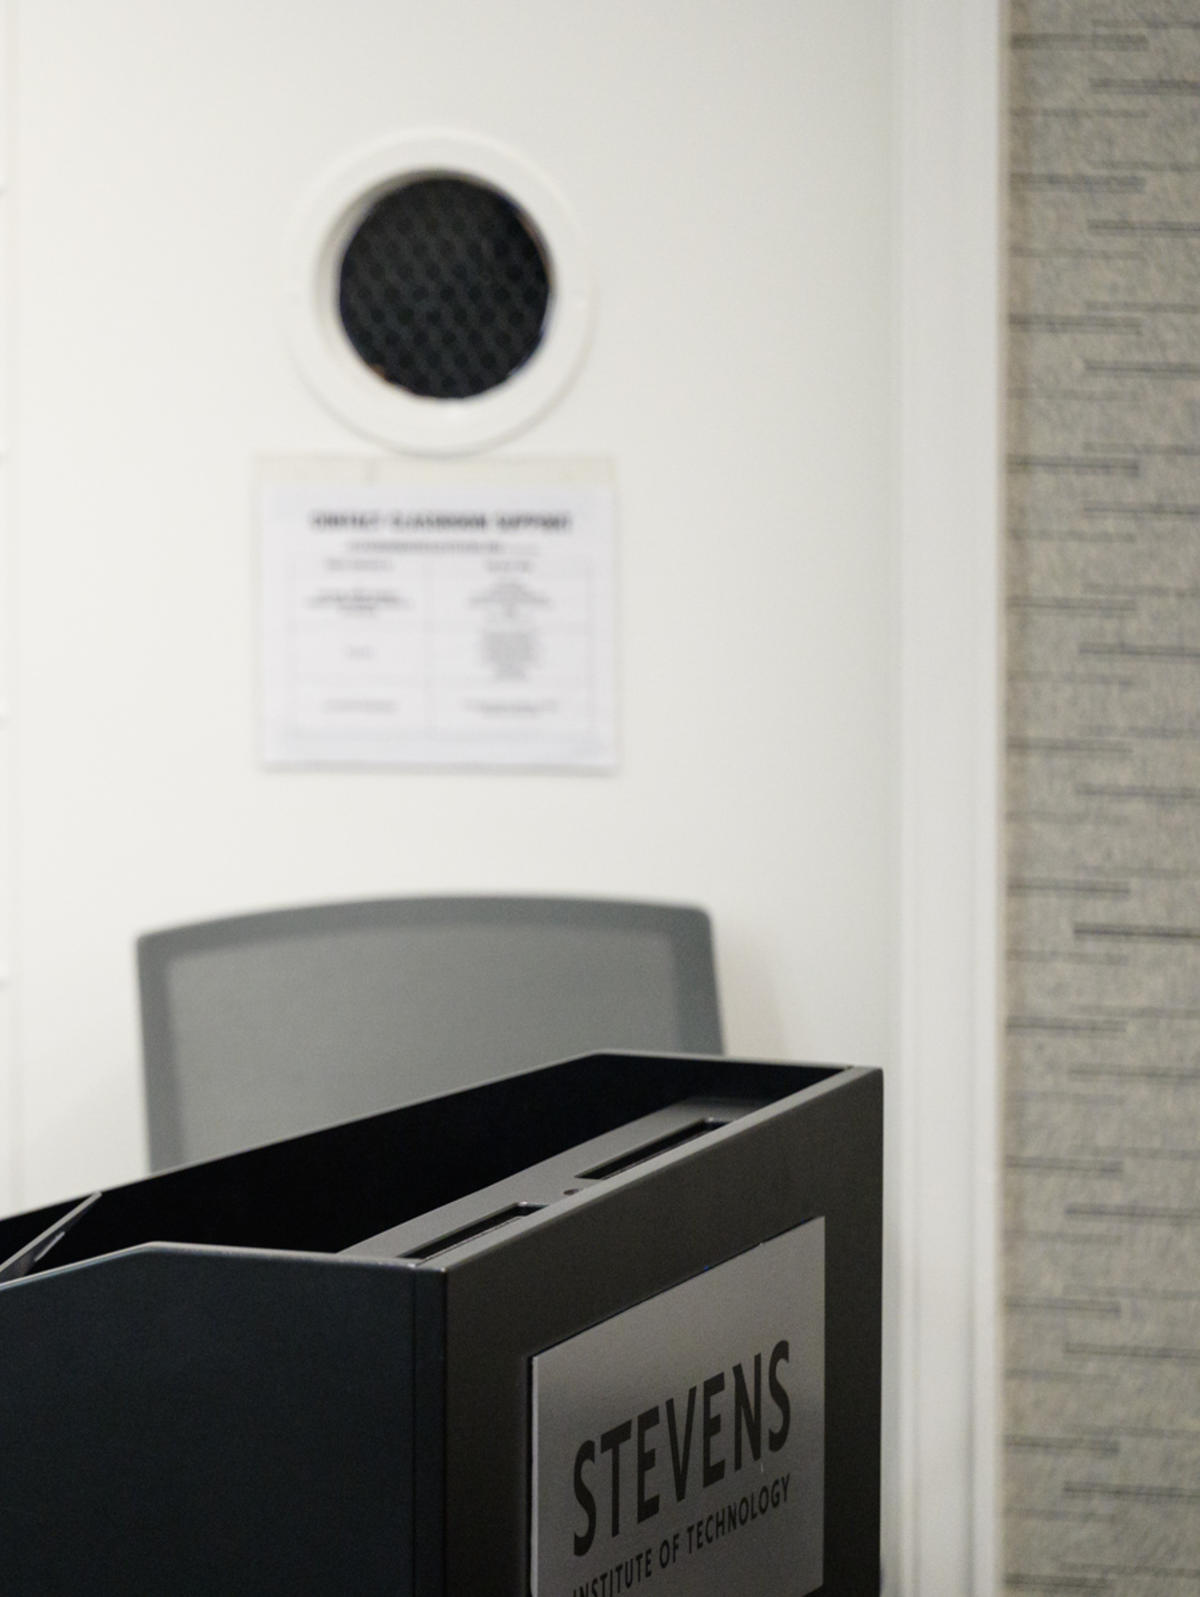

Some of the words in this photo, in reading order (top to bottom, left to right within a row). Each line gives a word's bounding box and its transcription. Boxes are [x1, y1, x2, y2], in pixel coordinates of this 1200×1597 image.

[573, 1340, 791, 1556] STEVENS
[573, 1548, 652, 1597] STITUTE
[659, 1533, 680, 1569] OF
[686, 1473, 791, 1554] TECHNOLOGY
